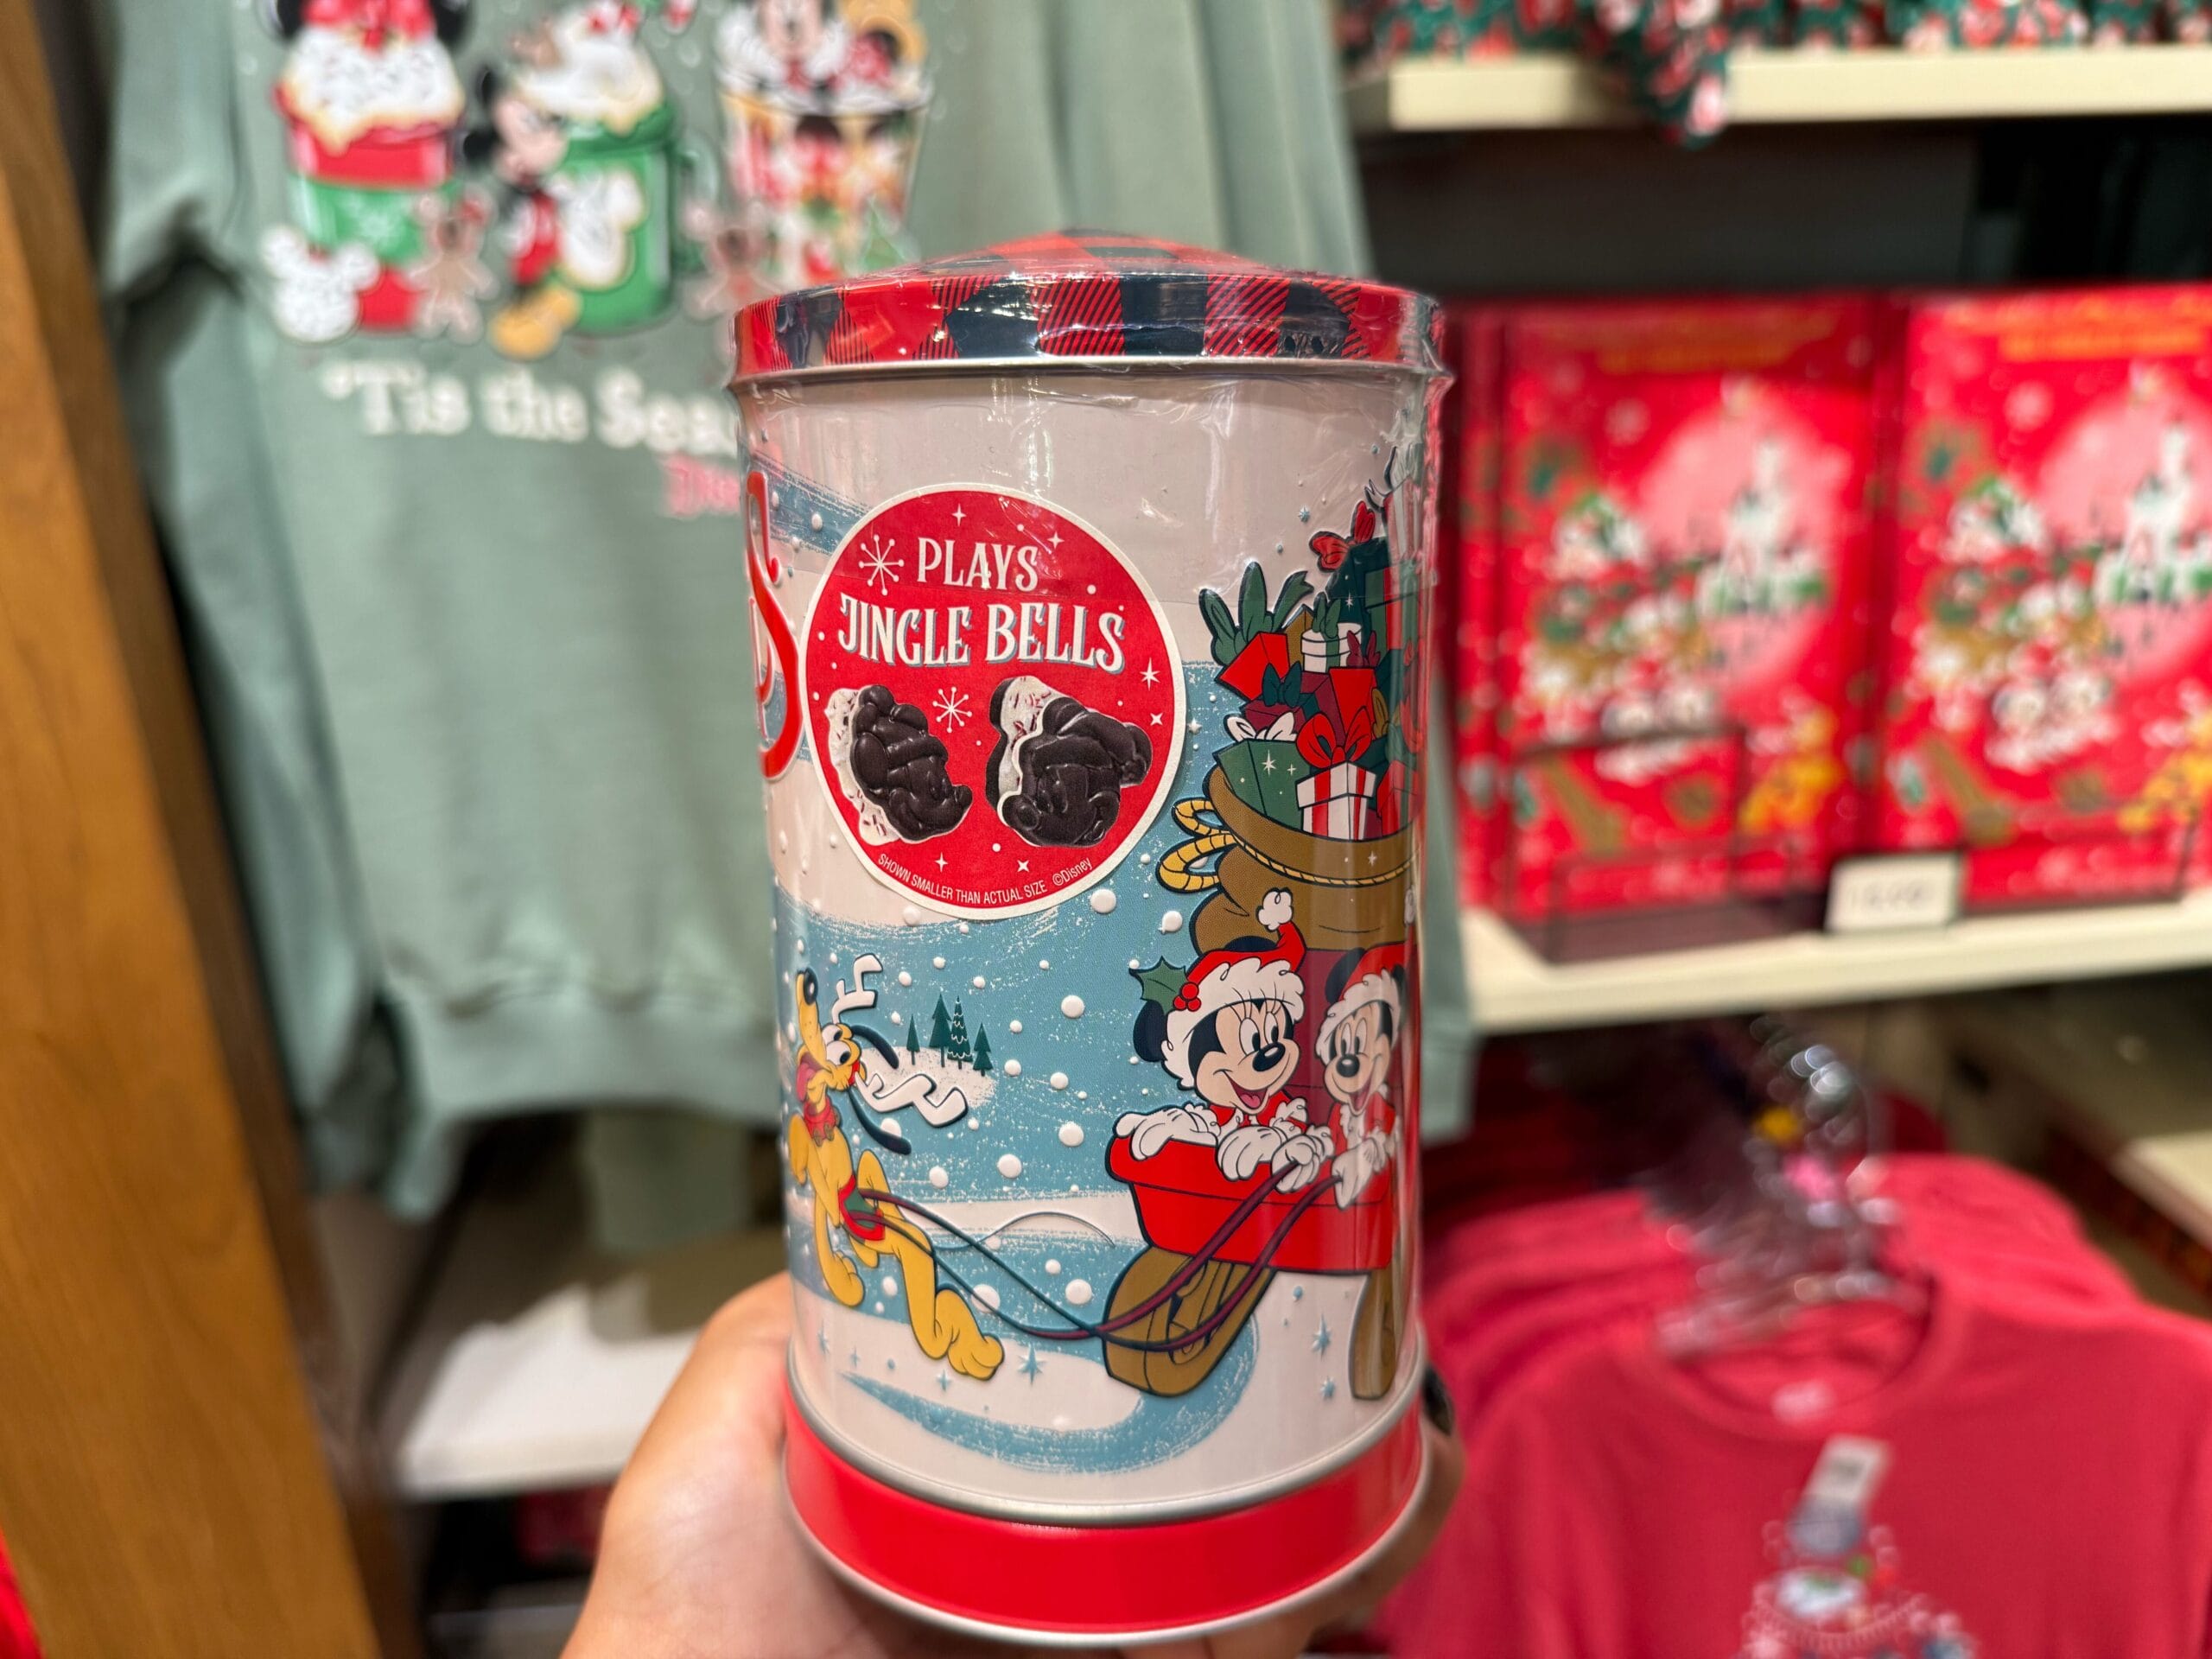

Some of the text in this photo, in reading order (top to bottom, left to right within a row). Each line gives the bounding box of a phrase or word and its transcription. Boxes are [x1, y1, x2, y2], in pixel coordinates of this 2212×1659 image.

[480, 366, 589, 442] the
[597, 367, 737, 458] Sea
[917, 537, 1039, 593] PLAYS
[838, 592, 1125, 674] JINGLE BELLS
[878, 854, 1048, 905] SHOWN SMALLER THAN ACTUAL SIZE
[1052, 857, 1093, 887] ©Disney
